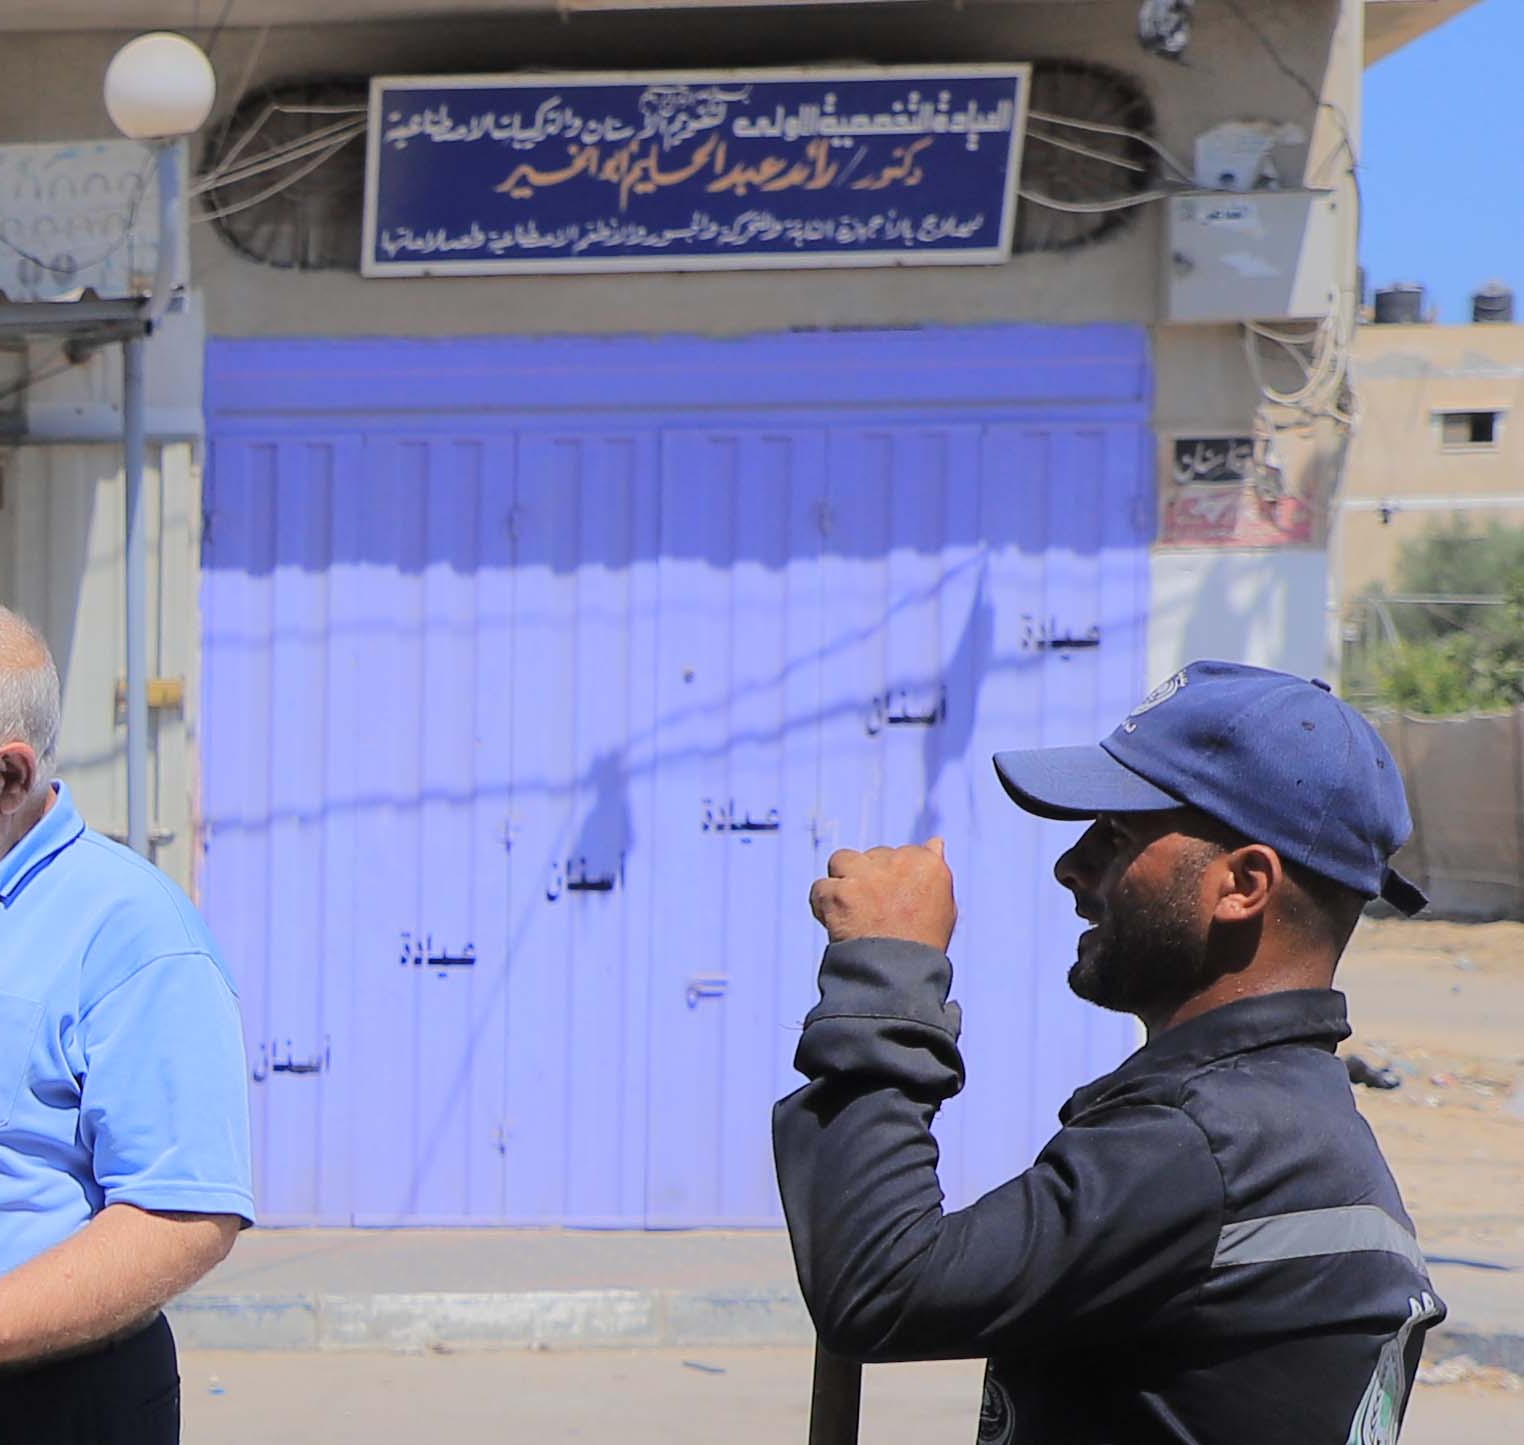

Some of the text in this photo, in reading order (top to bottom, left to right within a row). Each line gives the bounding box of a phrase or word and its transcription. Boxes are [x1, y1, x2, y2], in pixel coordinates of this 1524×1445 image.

[934, 90, 1014, 151] العيادة
[851, 135, 933, 191] دكتور
[1021, 612, 1101, 662] عيادة
[701, 797, 781, 845] عيادة
[400, 930, 477, 979] عيادة
